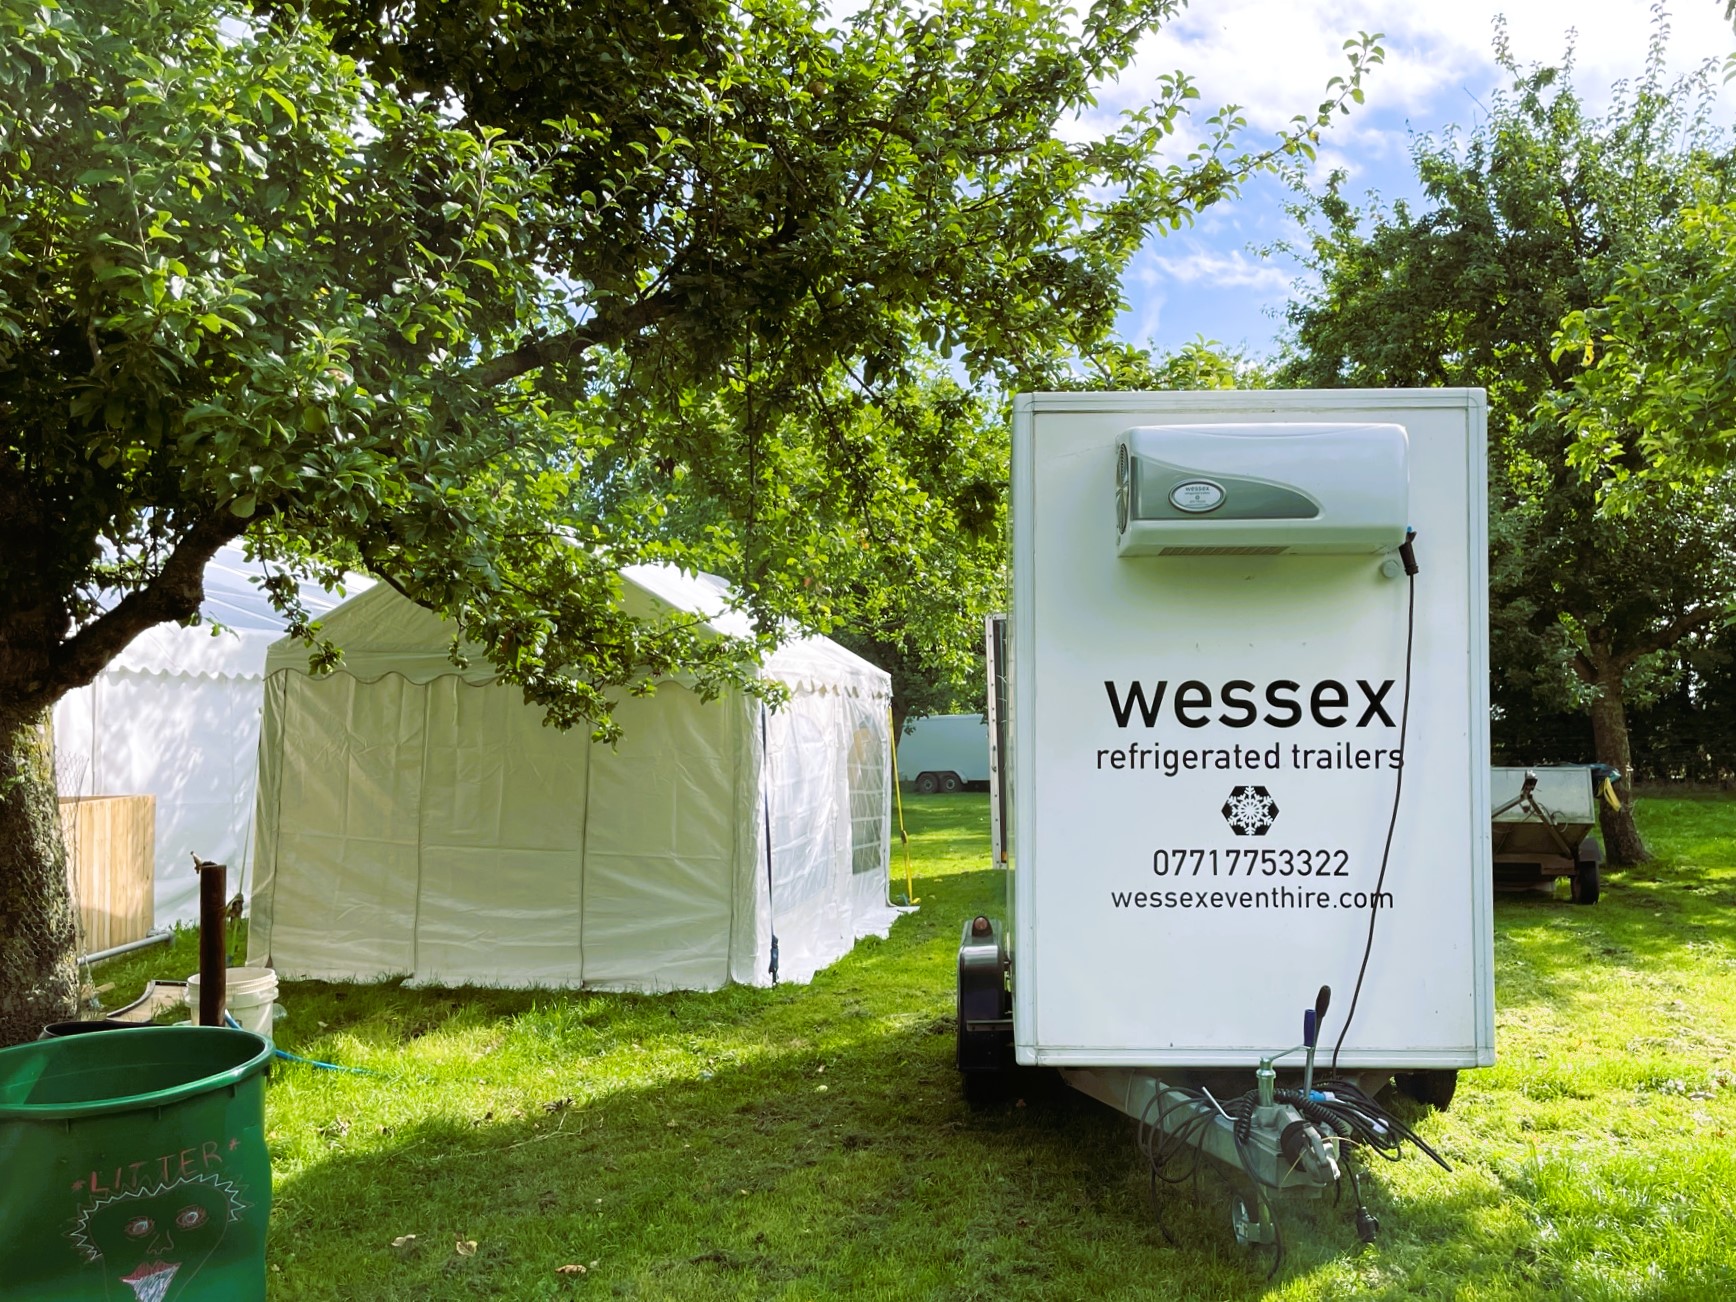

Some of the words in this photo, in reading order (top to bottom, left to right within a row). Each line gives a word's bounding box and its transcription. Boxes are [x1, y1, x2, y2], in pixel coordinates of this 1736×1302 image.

[1104, 679, 1397, 728] wessex
[1096, 742, 1281, 777] refrigerated
[1292, 742, 1405, 770] trailers
[1153, 849, 1350, 876] 07717753322
[1111, 886, 1394, 909] wessexeventhire.com
